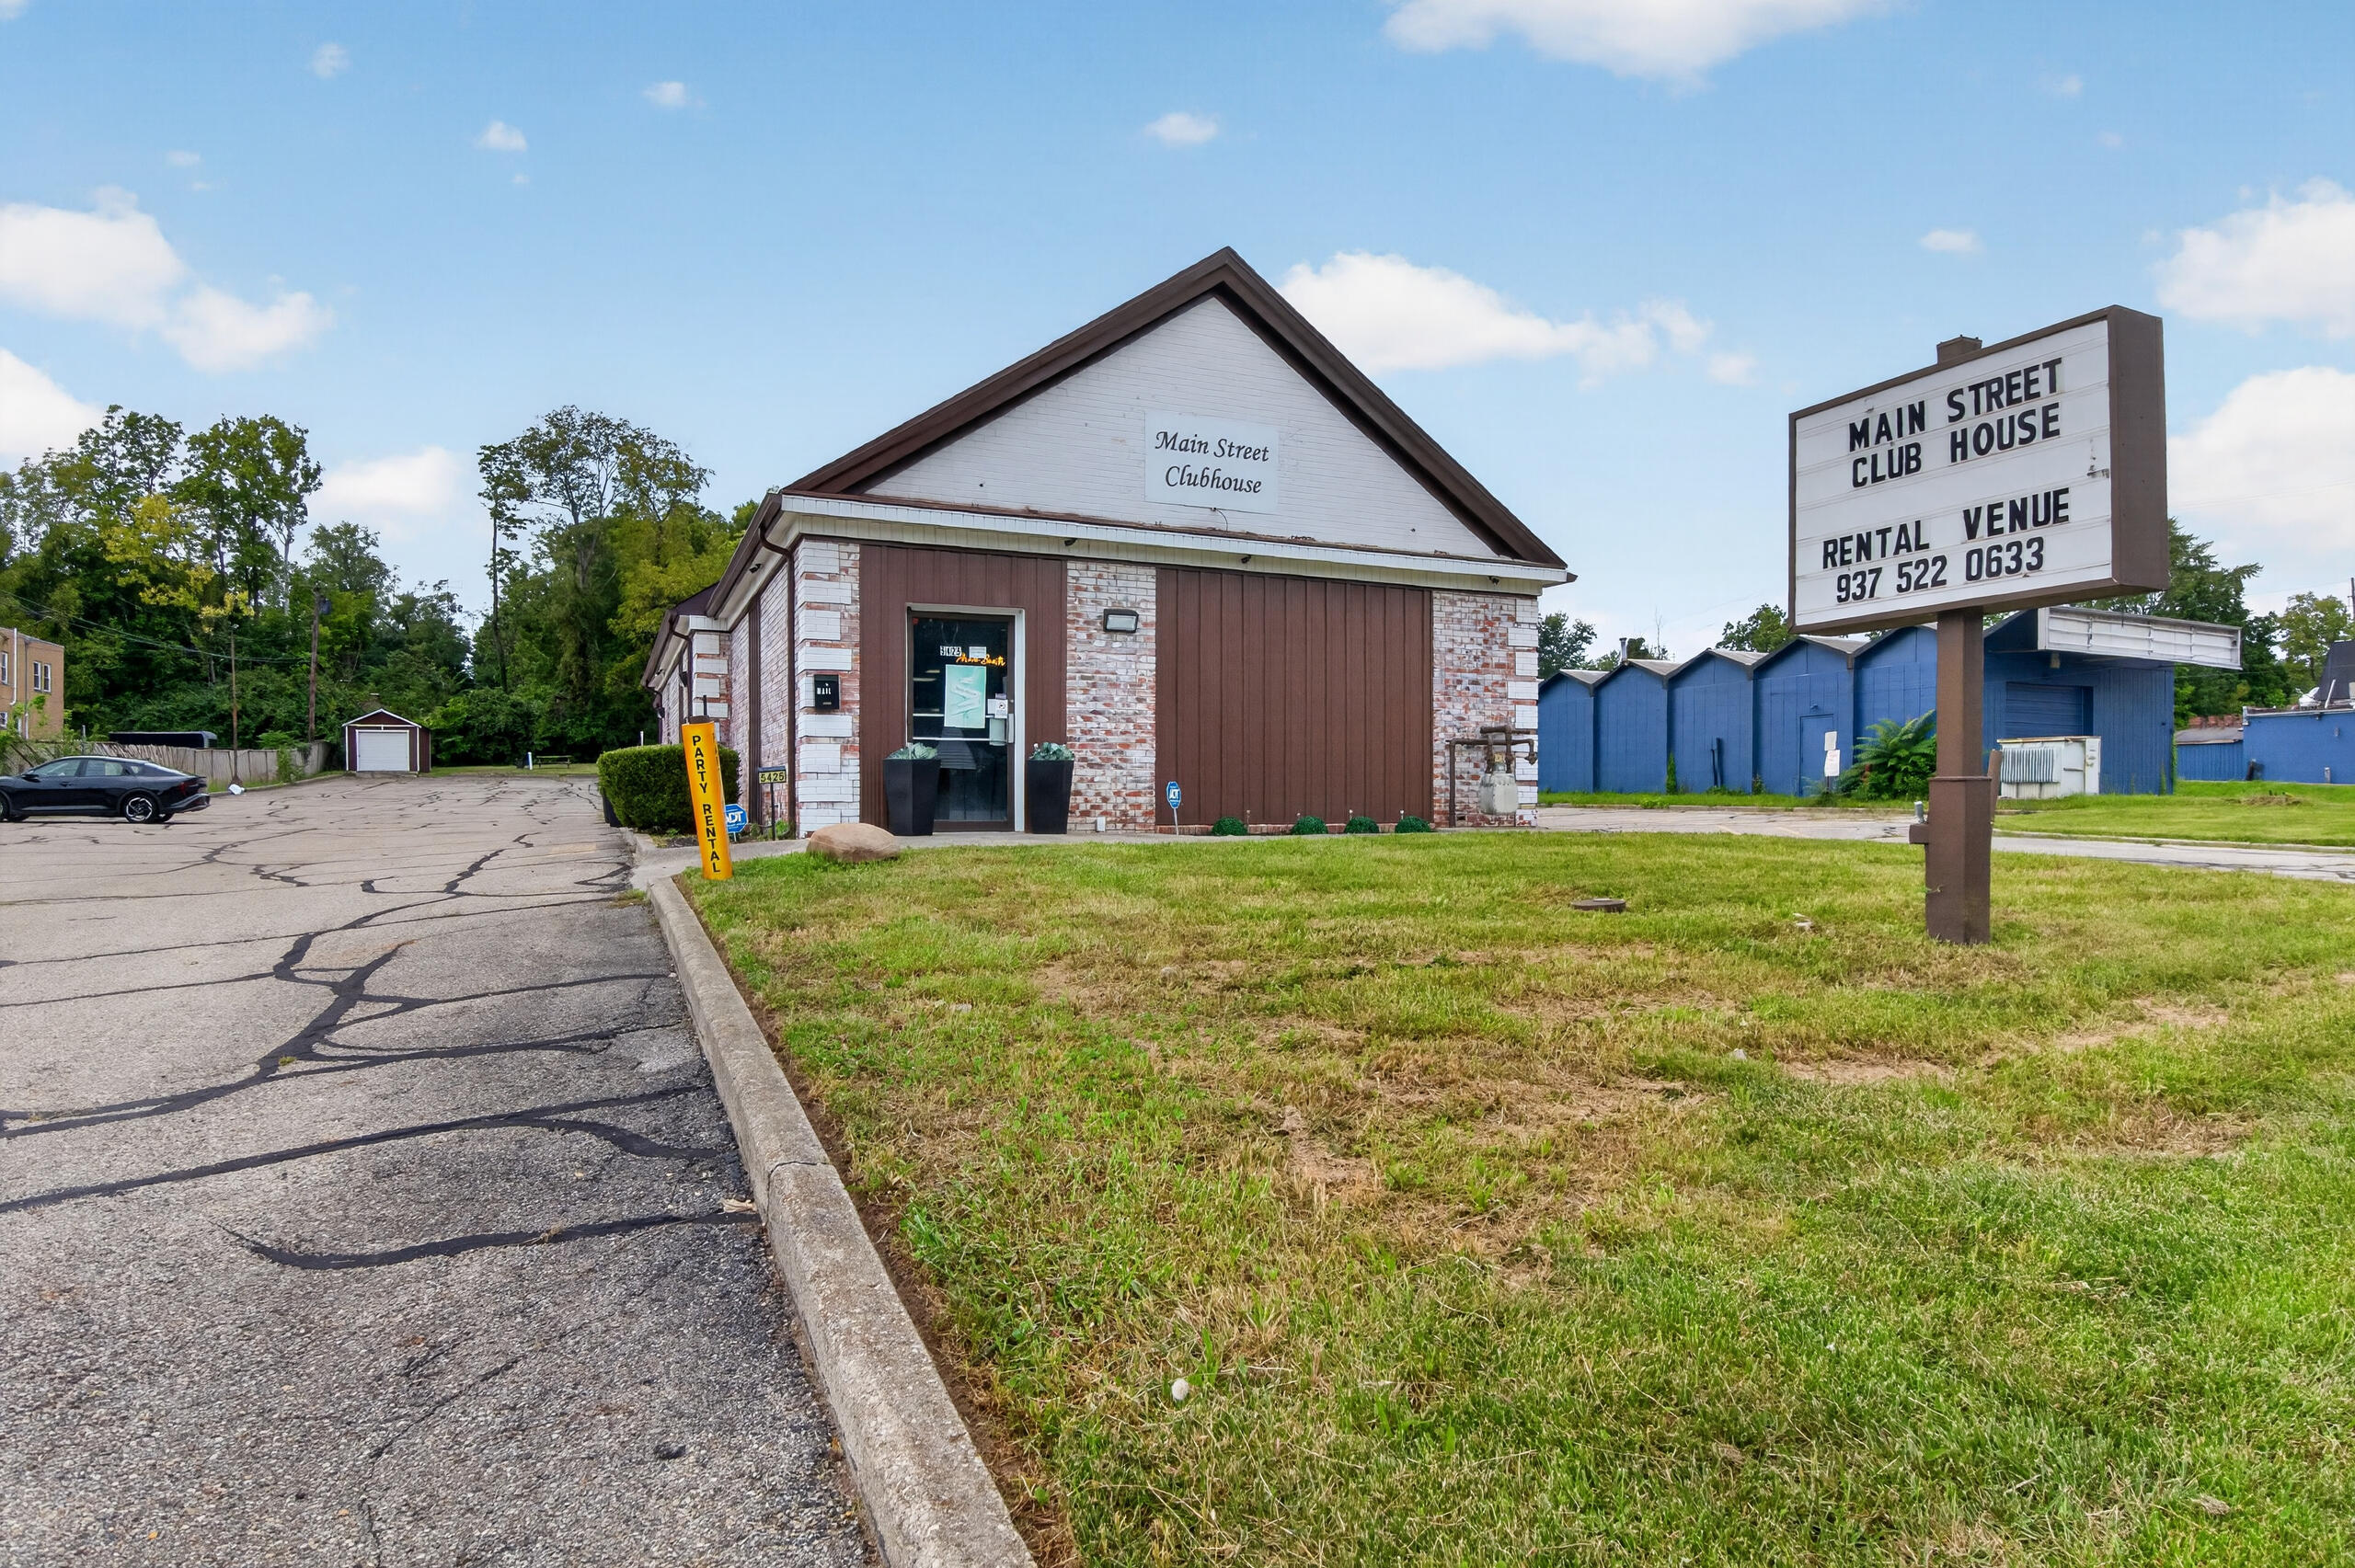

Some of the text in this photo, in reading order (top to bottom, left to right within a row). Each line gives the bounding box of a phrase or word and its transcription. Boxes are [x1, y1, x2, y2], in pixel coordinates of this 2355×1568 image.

[1849, 358, 2062, 452] MAIN STREET
[1155, 431, 1269, 462] Main Street
[1166, 465, 1261, 493] Clubhouse
[1853, 403, 2060, 487] CLUB HOUSE
[1823, 487, 2069, 569] RENTAL VENUE
[1837, 537, 2043, 602] 937 522 0633
[816, 687, 832, 695] MAIL
[692, 735, 721, 873] PARTY RENTAL
